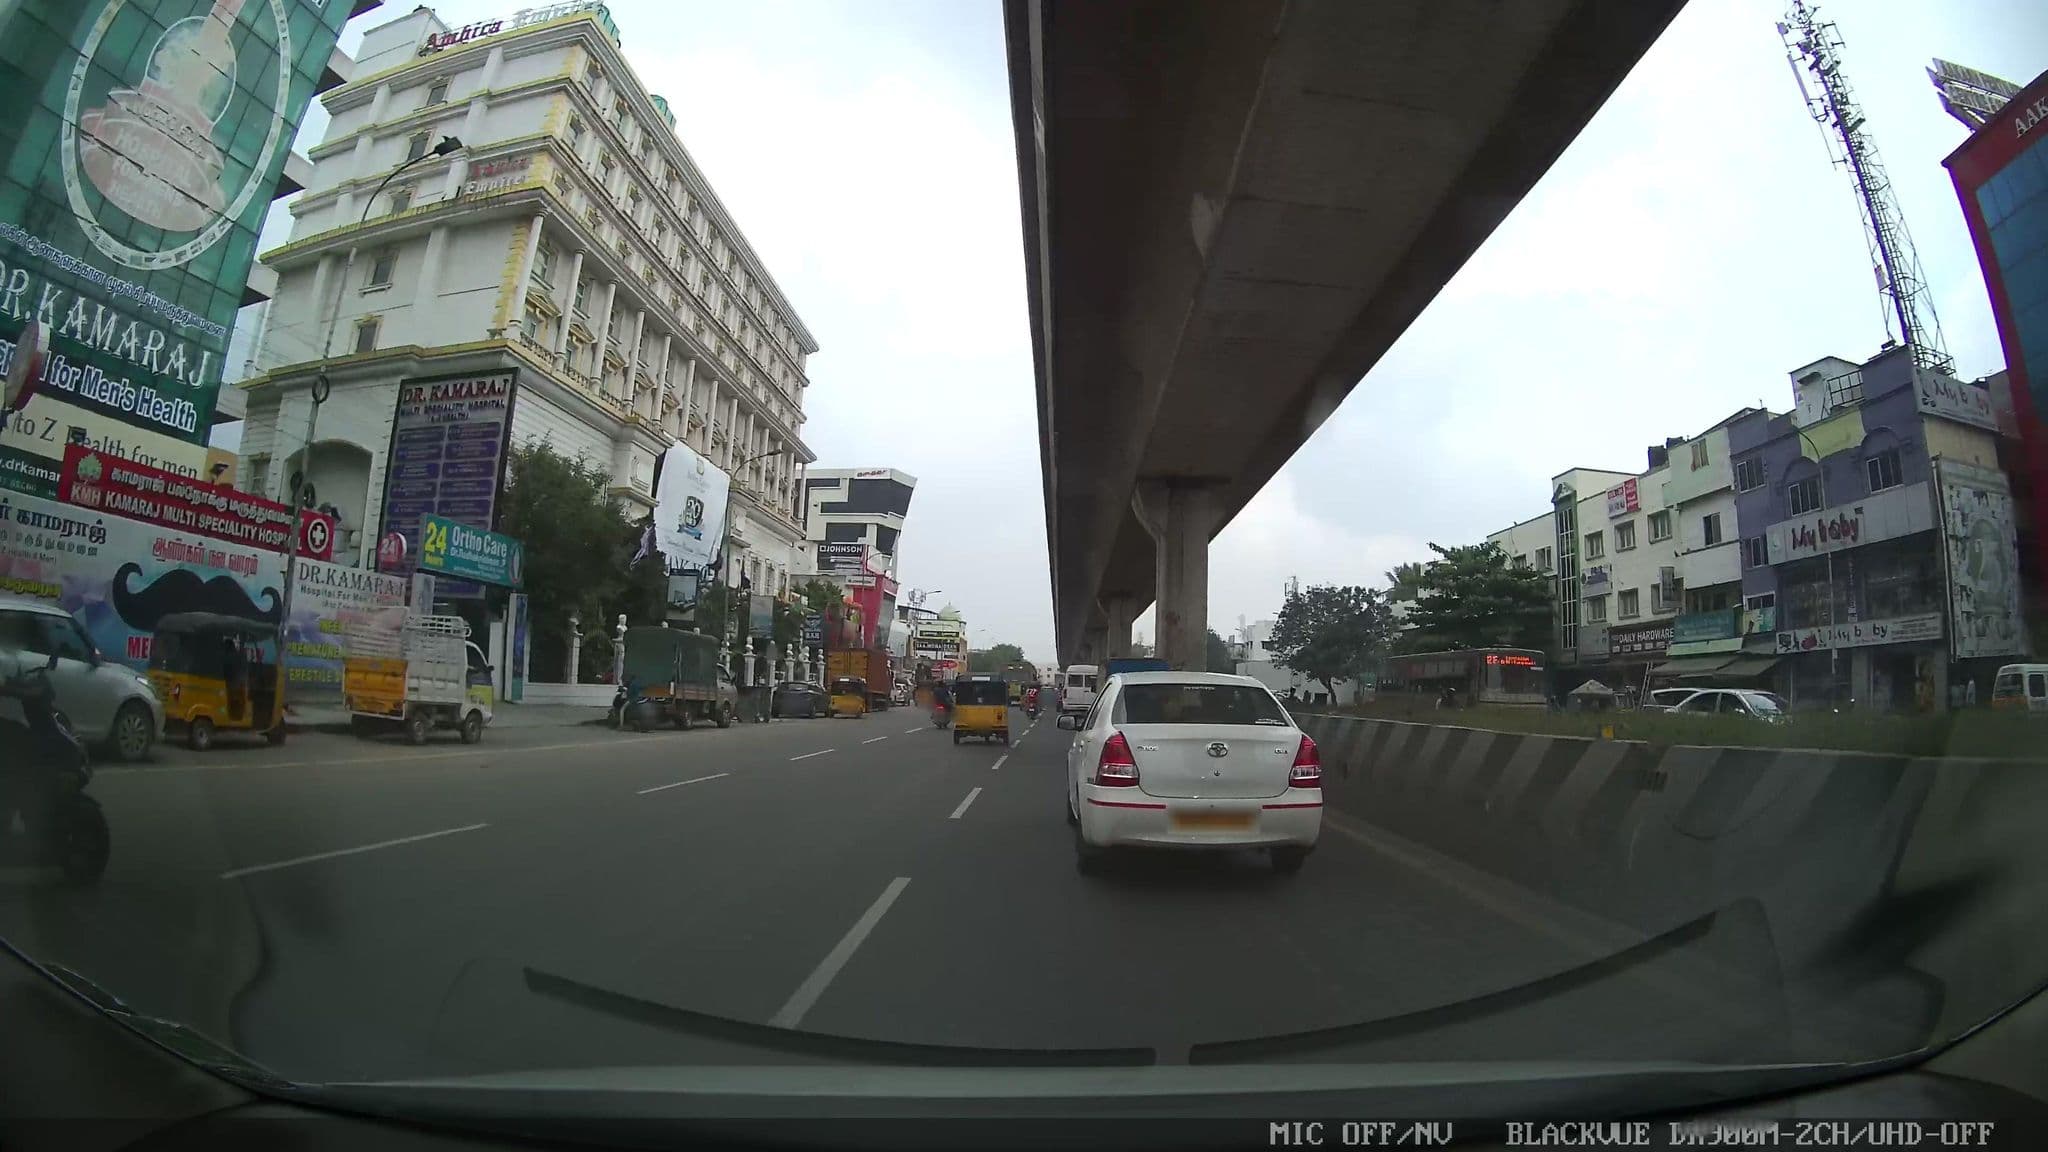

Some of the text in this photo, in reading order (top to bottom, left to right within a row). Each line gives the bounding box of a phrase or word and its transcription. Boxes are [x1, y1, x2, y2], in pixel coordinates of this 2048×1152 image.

[50, 354, 81, 392] for
[80, 364, 135, 412] Men's
[136, 385, 197, 433] Health
[430, 379, 511, 402] KAMARAJ
[15, 412, 36, 436] to
[39, 416, 58, 442] Z
[131, 446, 158, 469] for
[163, 460, 198, 481] men
[111, 466, 165, 494] காமராஜ்
[16, 508, 107, 545] காமராஜ்
[70, 481, 102, 508] KMH
[104, 490, 160, 517] KAMARAJ
[163, 504, 196, 528] MULTI
[198, 512, 257, 539] SPECIALITY
[424, 521, 447, 555] 24
[451, 526, 482, 552] Ortho
[482, 535, 508, 559] Care
[827, 545, 863, 553] JOHNSON
[1791, 524, 1817, 552] My
[299, 562, 404, 597] DR.KAMARAJ
[1620, 632, 1636, 644] DAILY
[1637, 627, 1675, 641] HARDWARE
